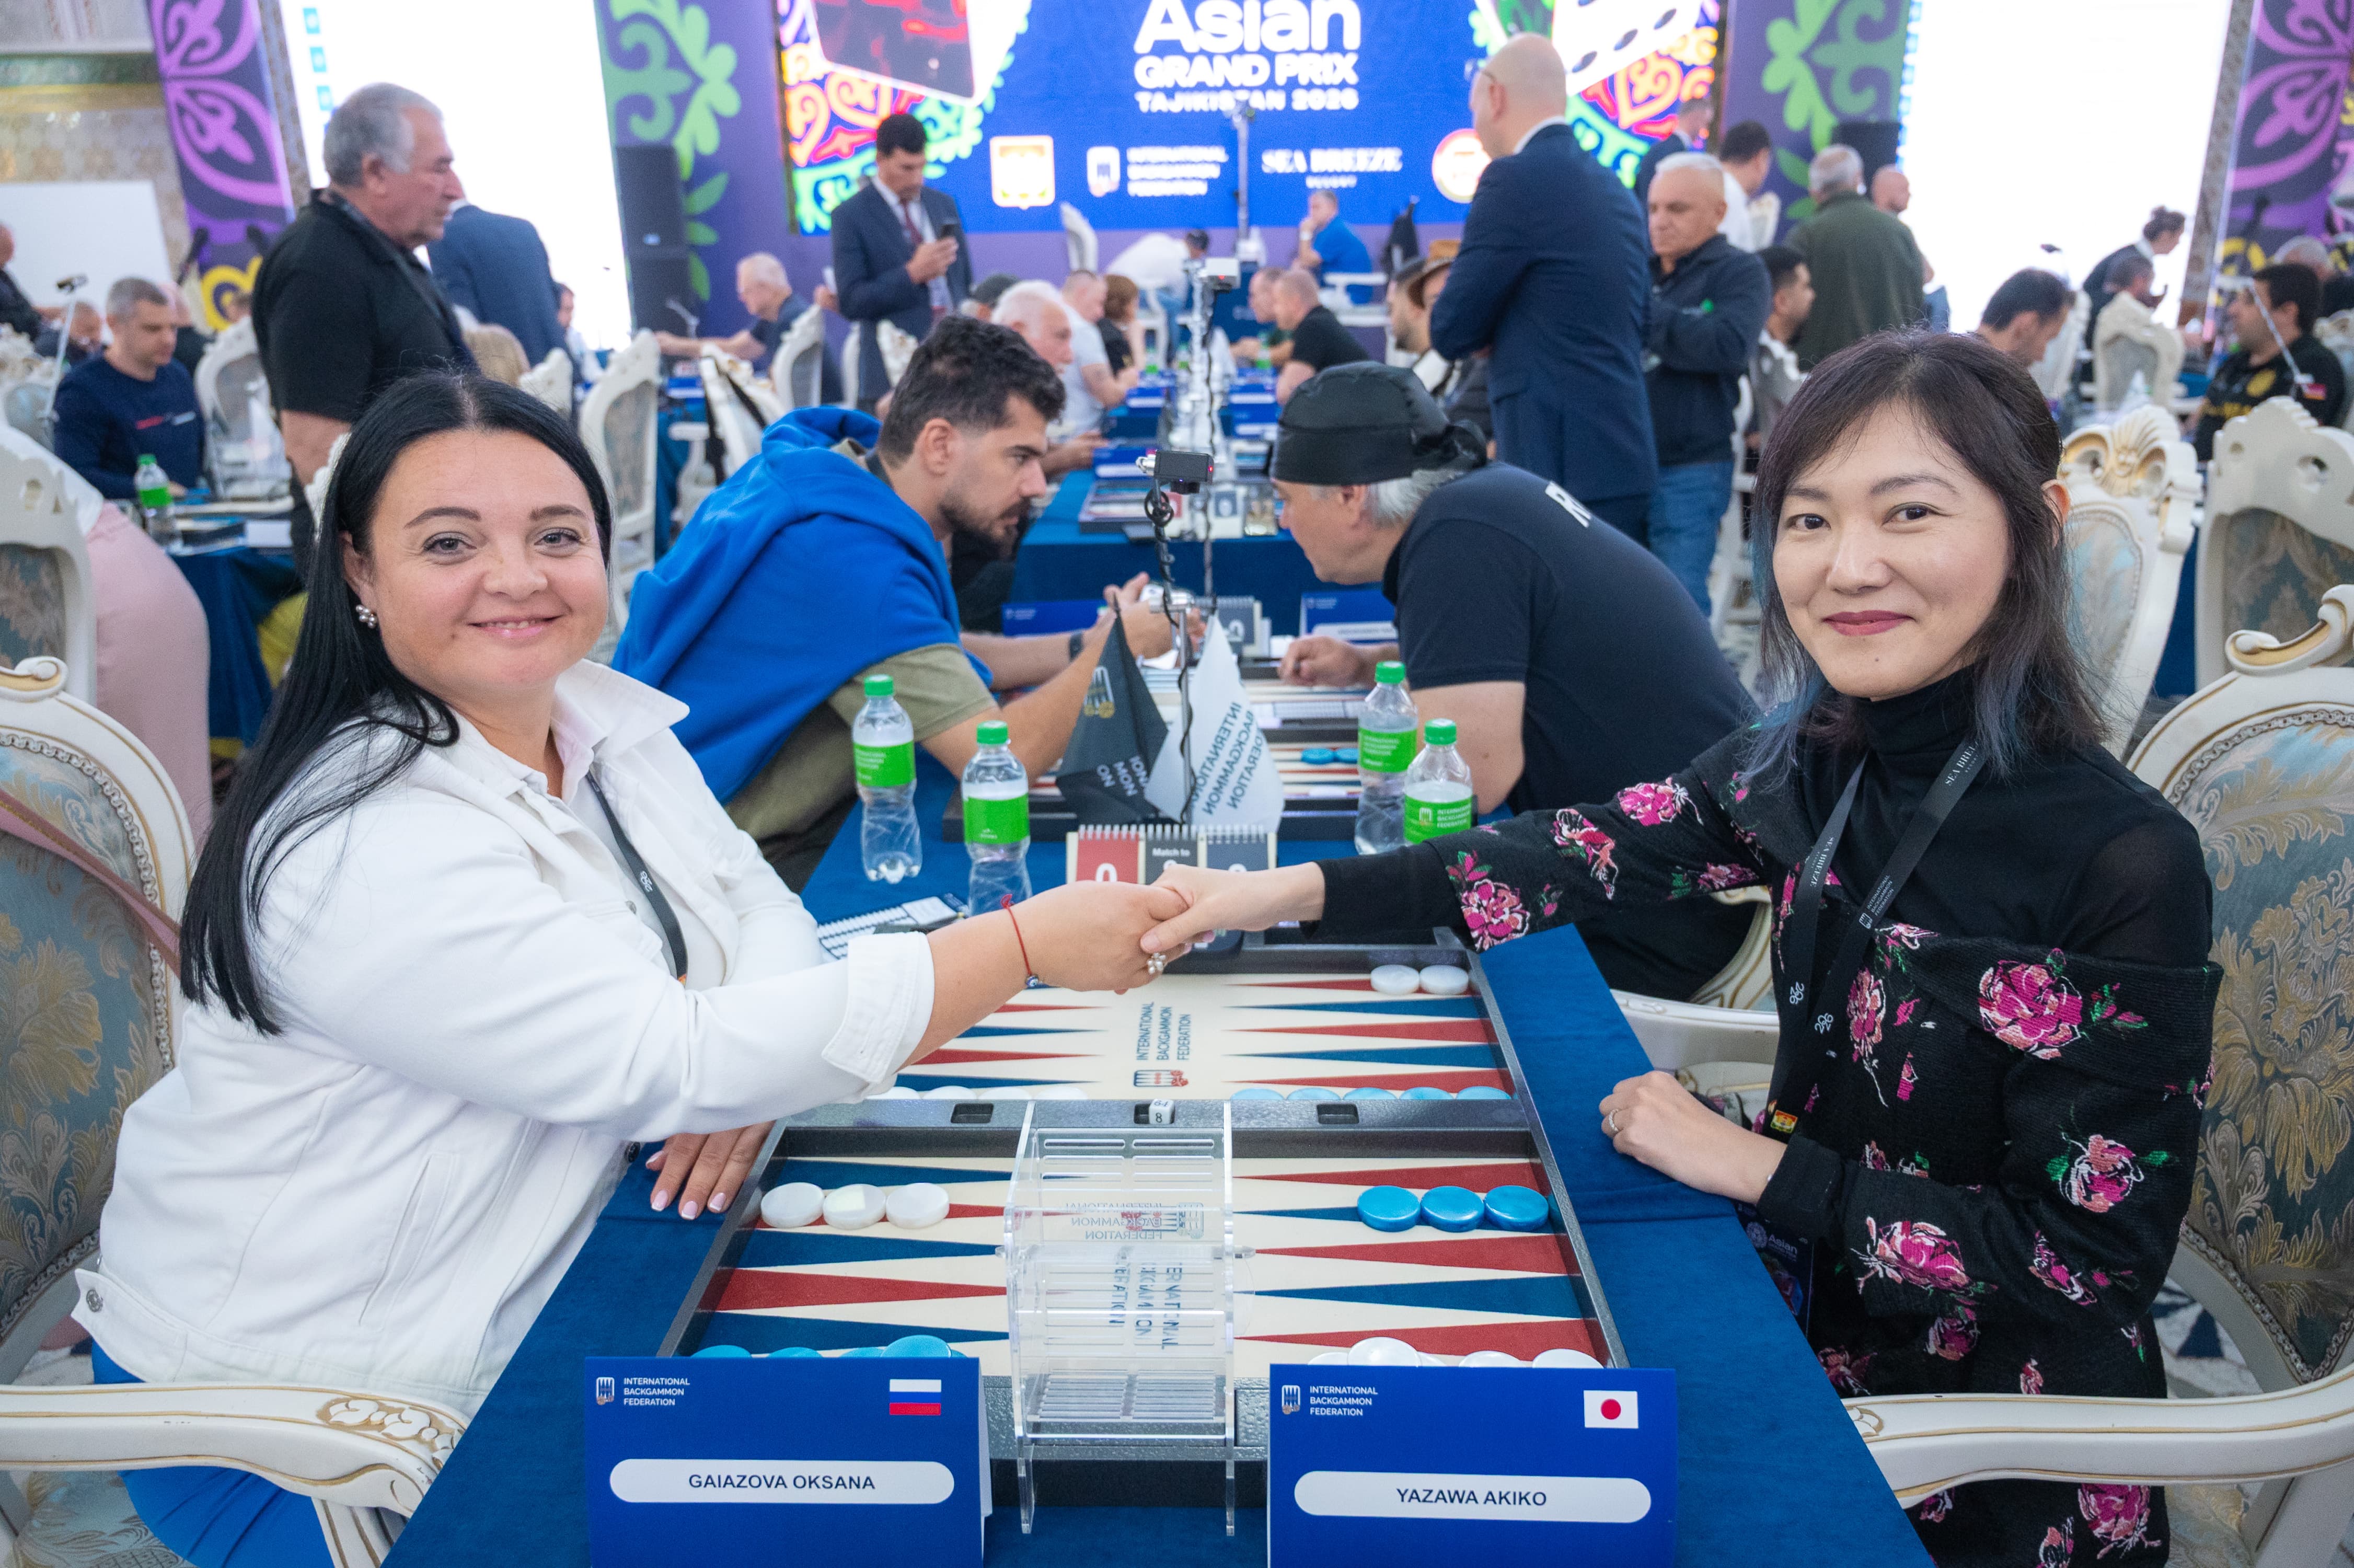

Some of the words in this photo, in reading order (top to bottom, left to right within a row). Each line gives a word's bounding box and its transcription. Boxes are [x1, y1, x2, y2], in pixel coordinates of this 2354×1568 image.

[1134, 0, 1361, 54] Asian
[1134, 54, 1271, 89] GRAND
[1275, 53, 1359, 86] PRIX
[1866, 875, 1890, 909] INTERNATIONAL
[1871, 880, 1893, 913] BACKGAMMON
[1874, 889, 1894, 916] FEDERATION
[1136, 1001, 1155, 1060] INTERNATIONAL
[1157, 1007, 1172, 1060] BACKGAMMON
[1177, 1014, 1191, 1060] FEDERATION
[1156, 1112, 1162, 1123] 8
[624, 1377, 690, 1386] INTERNATIONAL
[1309, 1386, 1378, 1395] INTERNATIONAL
[1309, 1396, 1372, 1405] BACKGAMMON
[1309, 1407, 1363, 1416] FEDERATION
[689, 1473, 788, 1489] GAIAZOVA
[793, 1474, 875, 1490] OKSANA
[1397, 1488, 1479, 1505] YAZAWA
[1483, 1490, 1547, 1506] AKIKO
